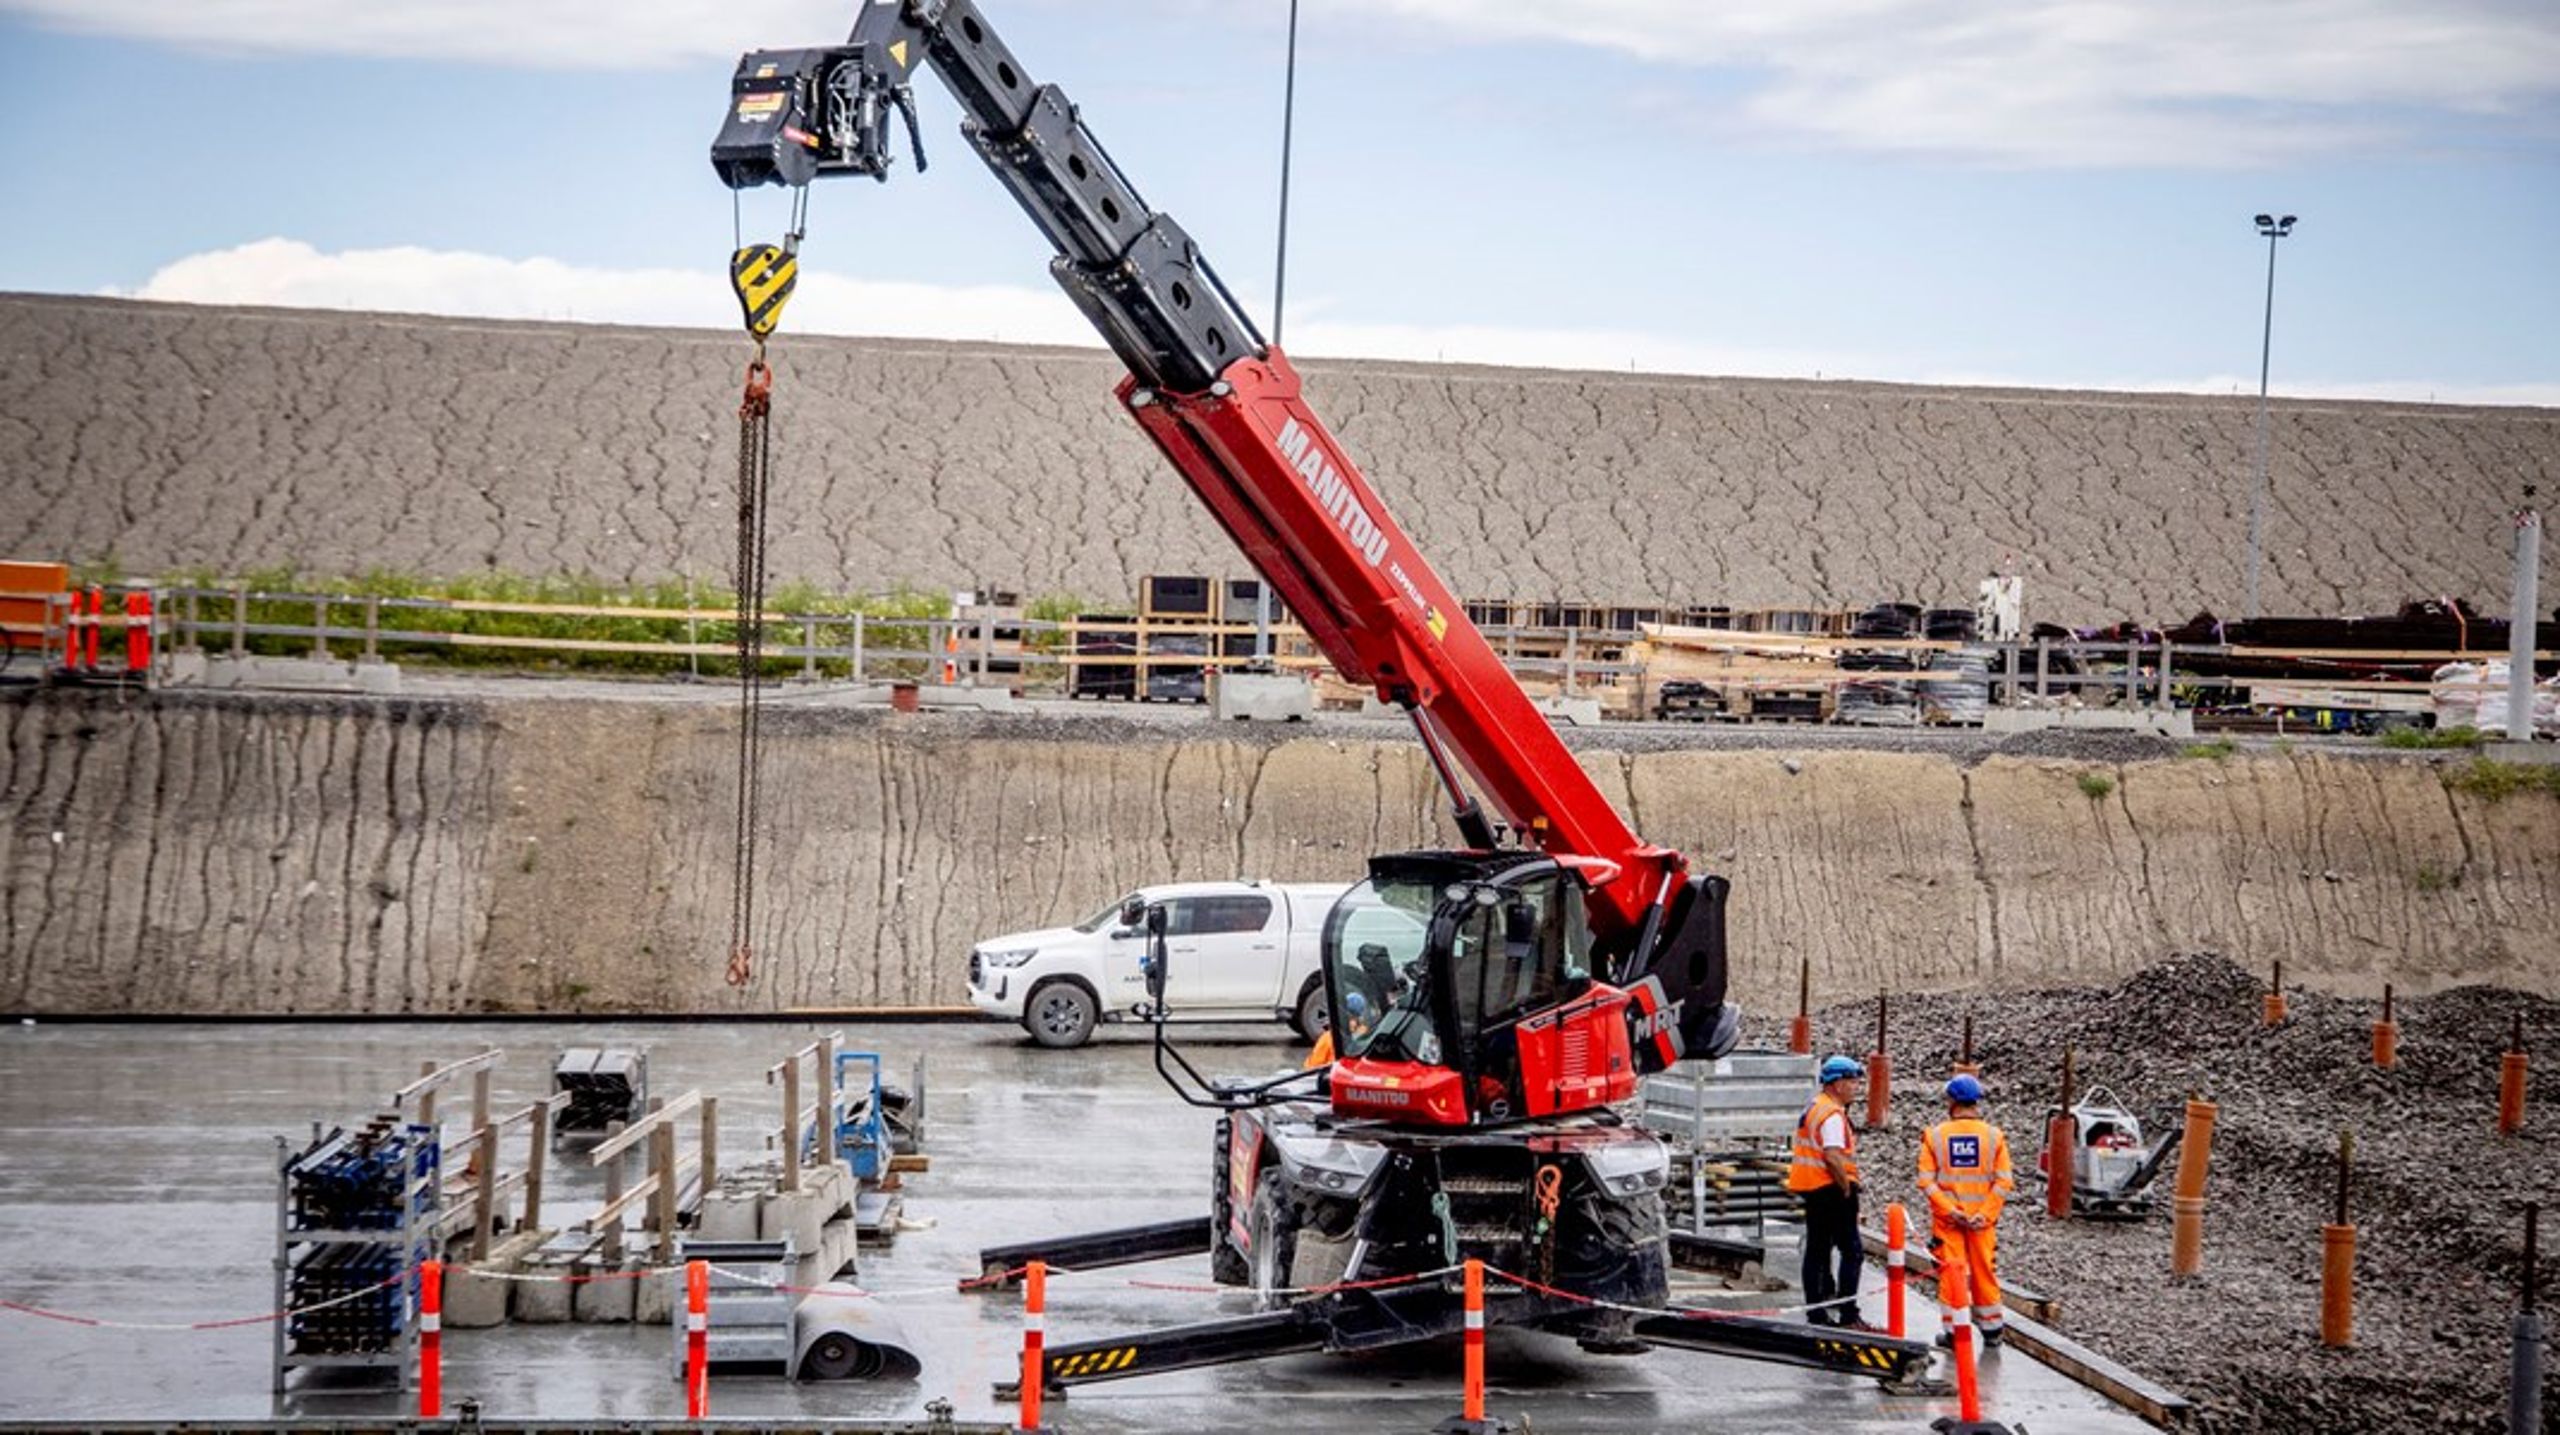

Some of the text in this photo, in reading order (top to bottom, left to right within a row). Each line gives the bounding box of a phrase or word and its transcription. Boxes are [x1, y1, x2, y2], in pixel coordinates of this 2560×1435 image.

[1276, 417, 1389, 566] MANITOU
[1633, 998, 1685, 1043] MRT
[1345, 1086, 1409, 1106] MANITOU
